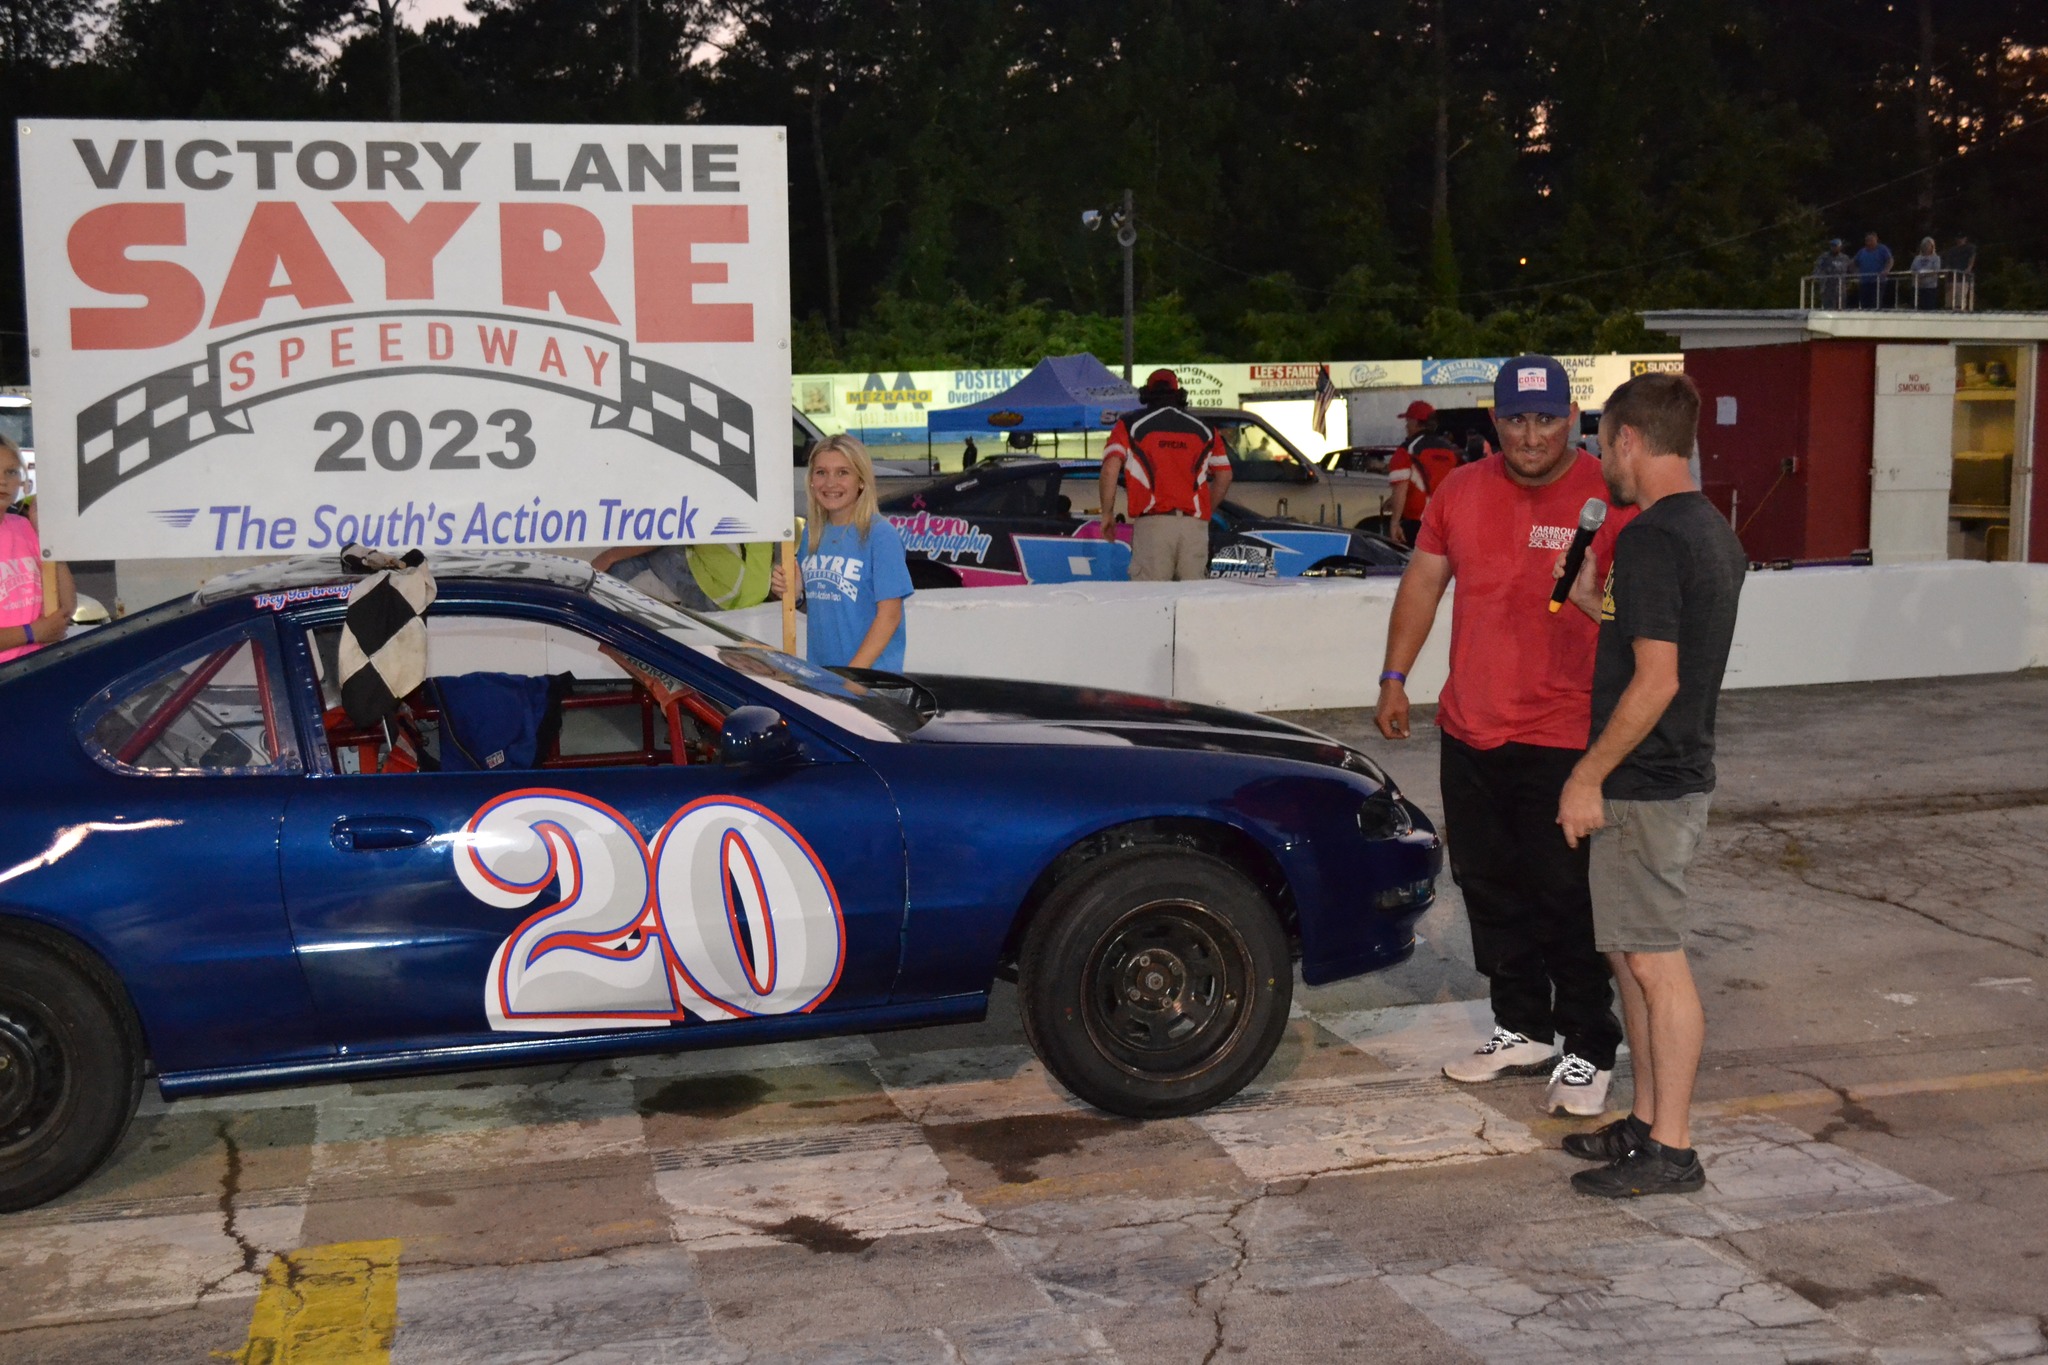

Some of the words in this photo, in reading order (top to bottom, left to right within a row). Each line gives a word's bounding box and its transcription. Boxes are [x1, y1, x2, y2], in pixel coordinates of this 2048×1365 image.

[72, 139, 481, 191] VICTORY
[513, 142, 740, 193] LANE
[67, 201, 754, 350] SAYRE
[228, 322, 610, 391] SPEEDWAY
[955, 369, 1024, 390] POSTEN'S
[1178, 377, 1202, 385] Auto
[1255, 366, 1284, 379] LEE'S
[1518, 376, 1546, 384] COSTA
[1908, 374, 1920, 382] NO
[850, 391, 930, 402] MEZRANO
[1897, 383, 1931, 393] SMOKING
[1196, 398, 1223, 407] 4030
[313, 408, 536, 472] 2023
[209, 505, 297, 551] The
[308, 501, 456, 550] South's
[461, 495, 588, 546] Action
[599, 495, 699, 542] Track
[255, 592, 286, 611] Trey
[454, 787, 847, 1031] 20
